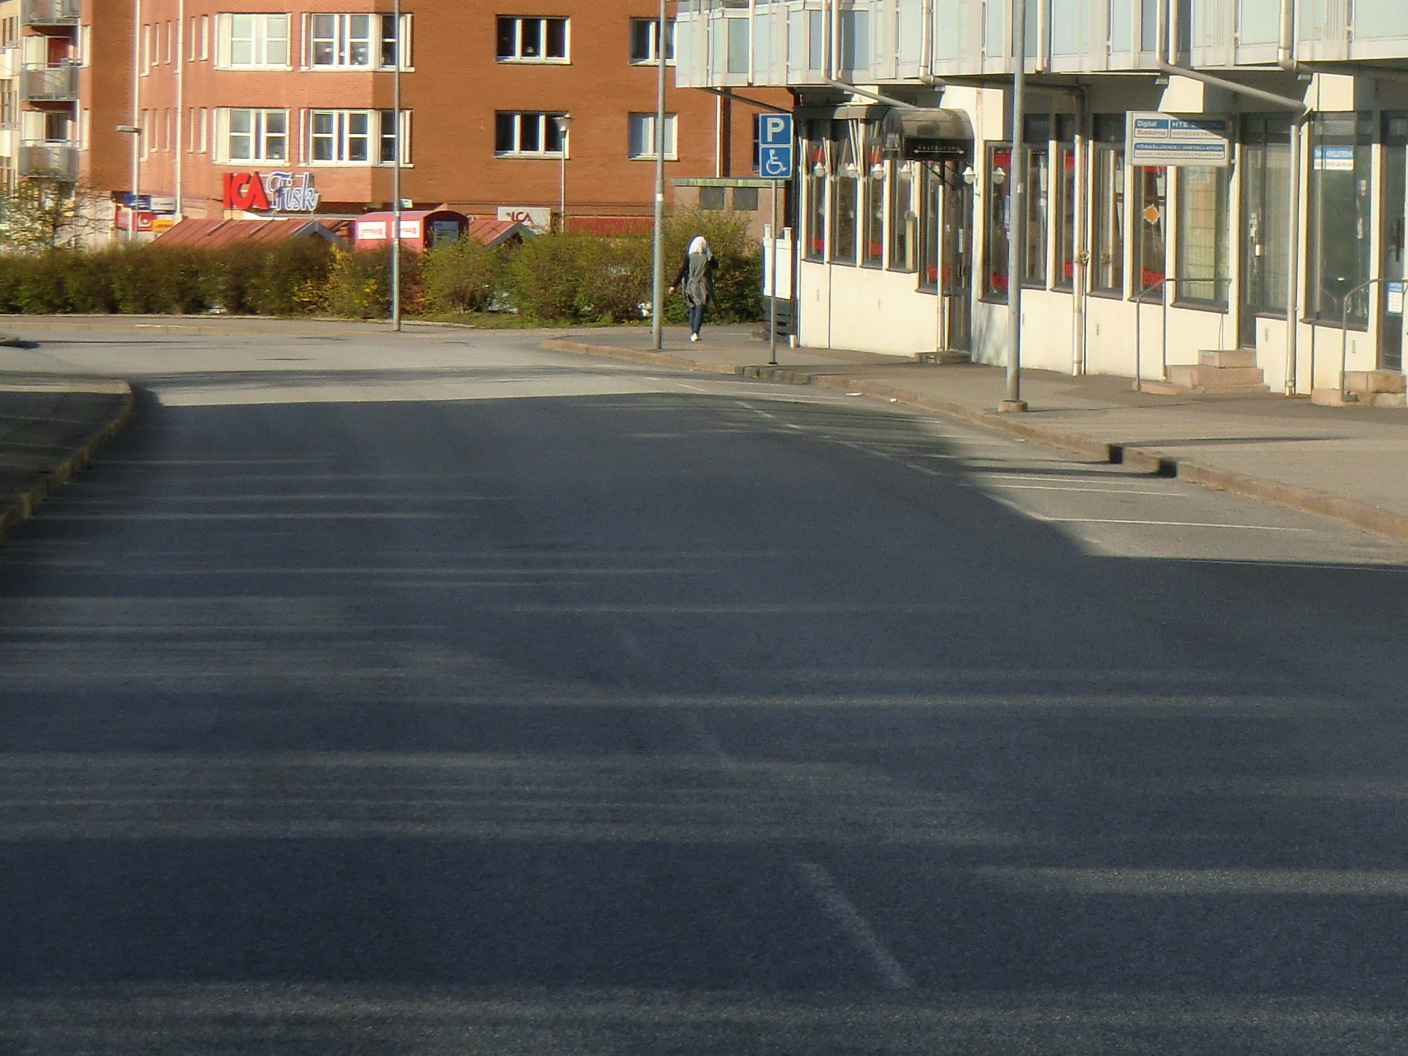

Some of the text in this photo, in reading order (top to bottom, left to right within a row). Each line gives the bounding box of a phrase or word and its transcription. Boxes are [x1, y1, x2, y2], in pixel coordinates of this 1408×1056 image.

[766, 117, 785, 142] P
[222, 170, 320, 211] ICA Fisk
